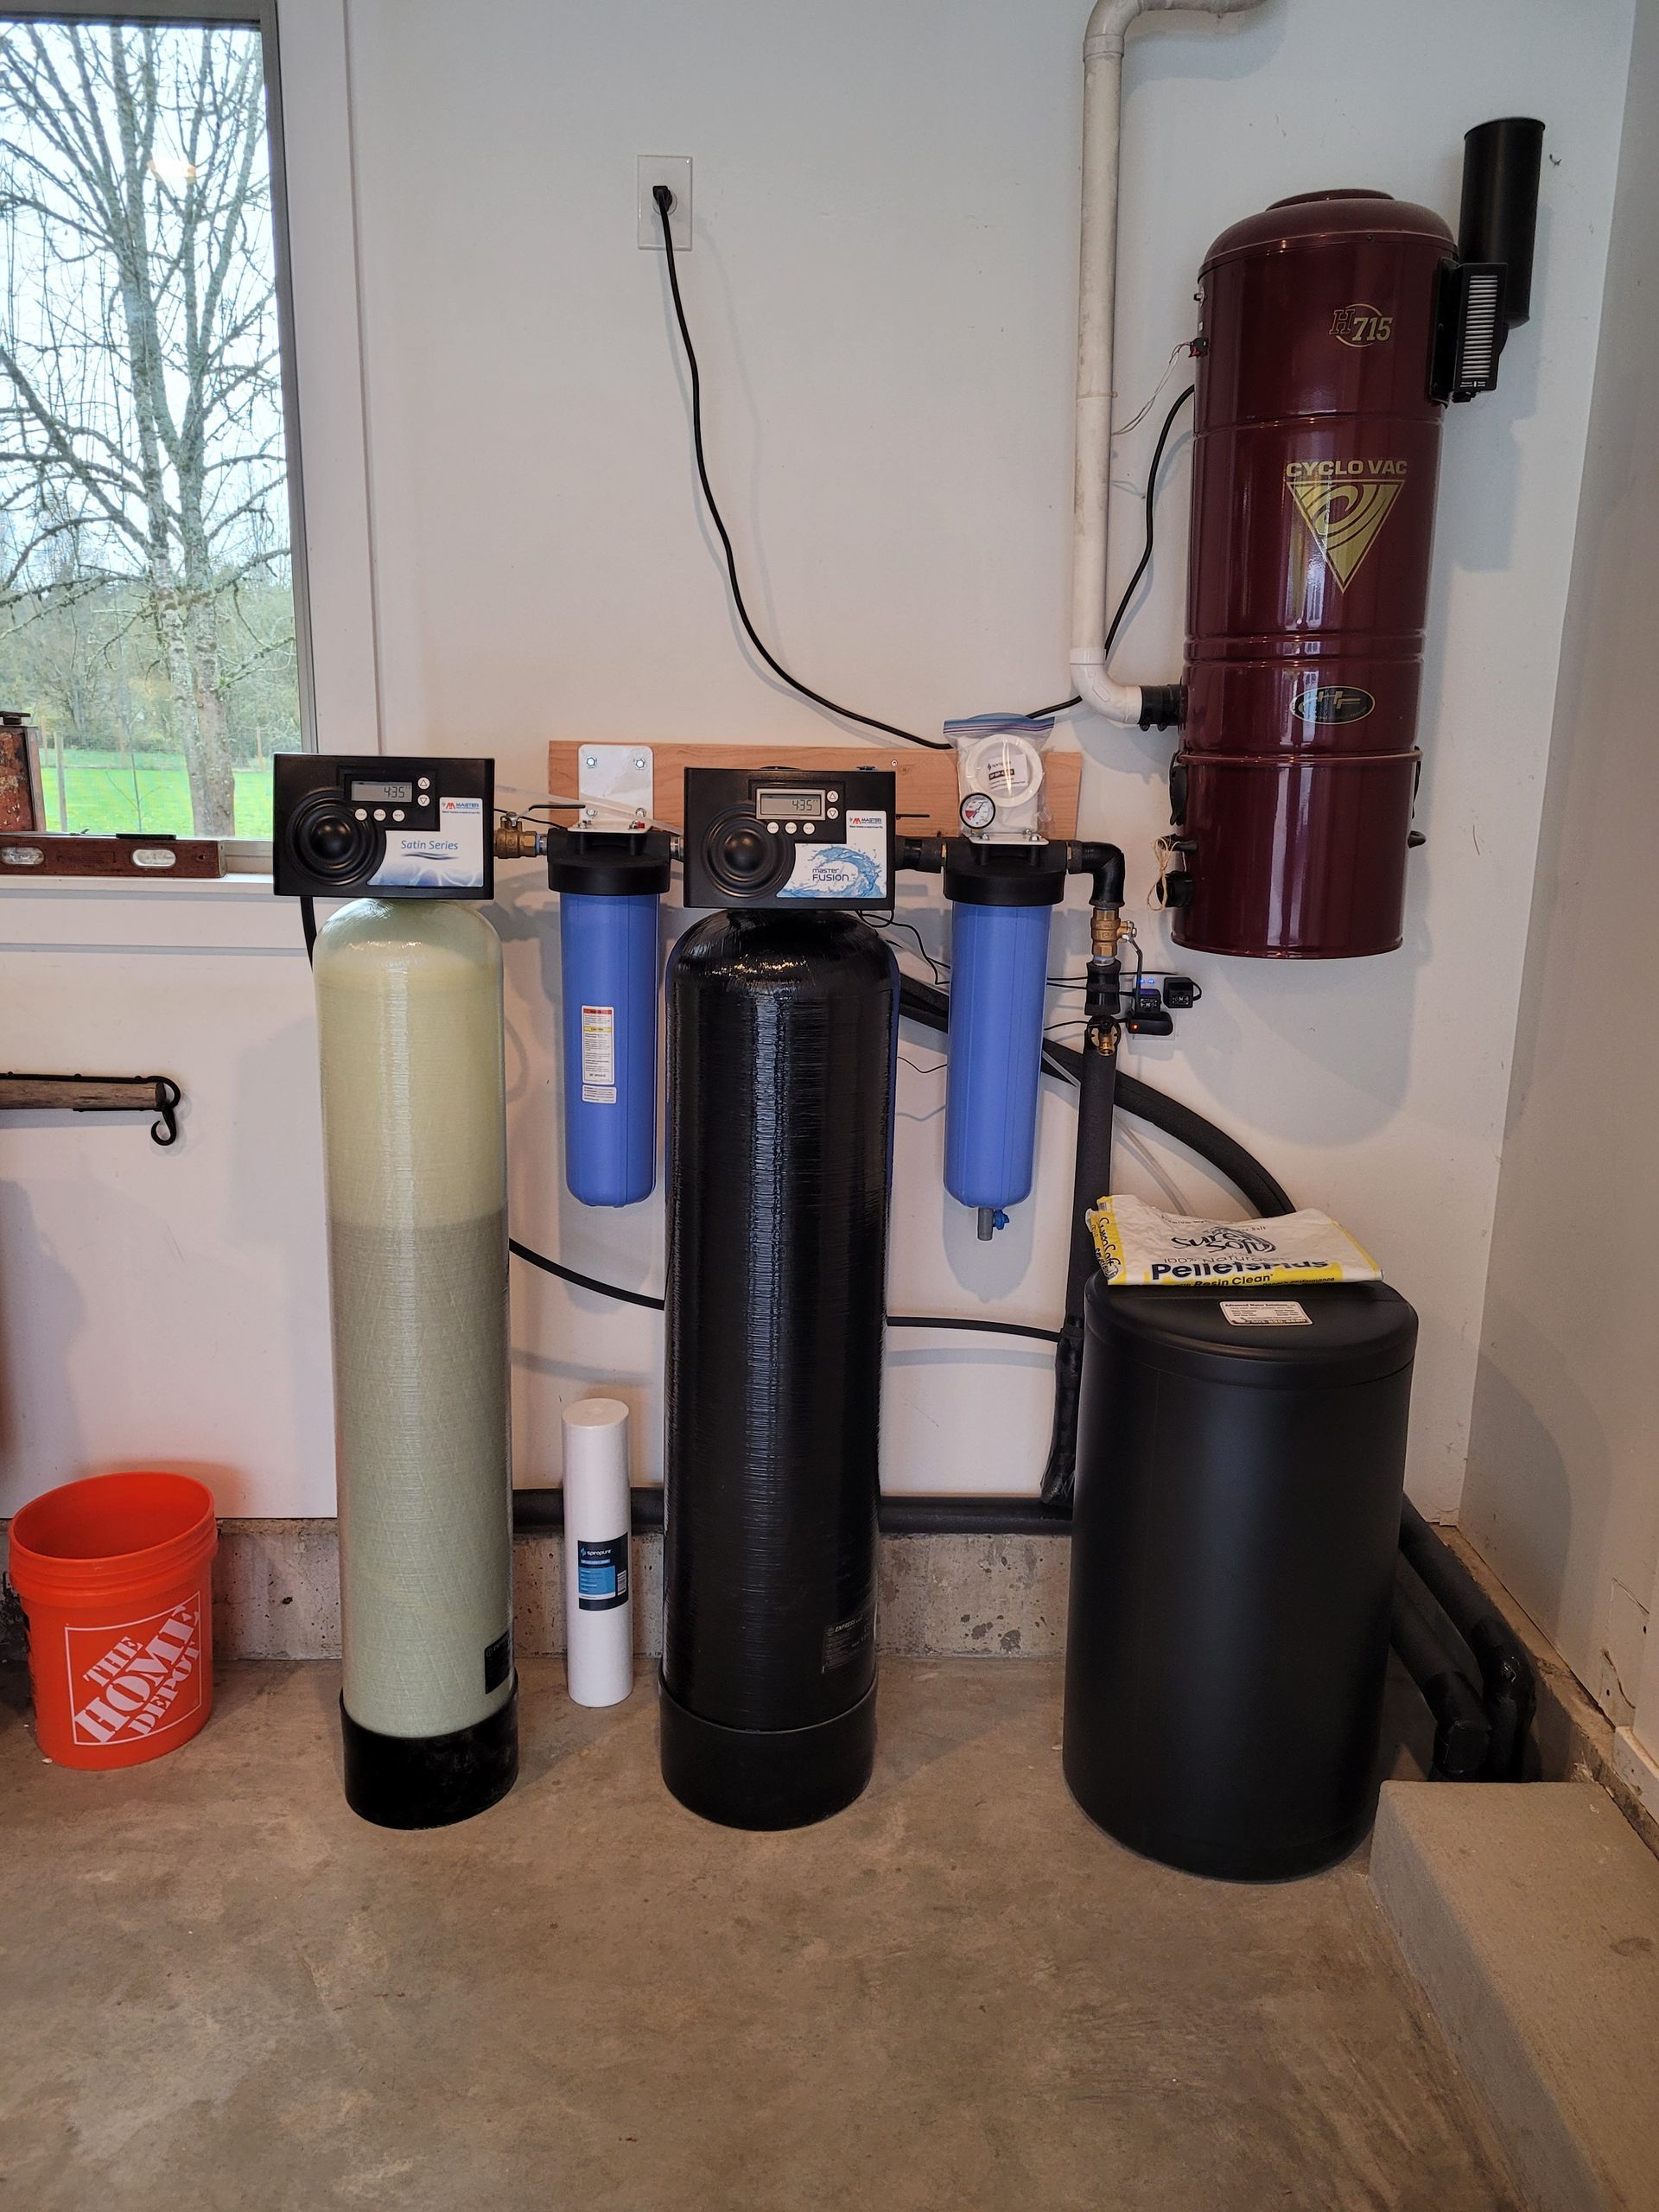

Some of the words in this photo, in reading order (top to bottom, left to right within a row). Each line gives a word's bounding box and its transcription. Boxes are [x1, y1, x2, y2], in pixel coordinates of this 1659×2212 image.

[1286, 460, 1367, 478] CYCLO
[1368, 459, 1408, 476] VAC
[384, 786, 404, 798] 435
[792, 799, 813, 811] 435
[401, 840, 426, 850] Satin
[429, 840, 459, 850] Series
[1232, 1273, 1271, 1284] Clean
[83, 1636, 143, 1688] THE
[74, 1605, 200, 1744] HOME
[128, 1640, 200, 1736] DEPOT
